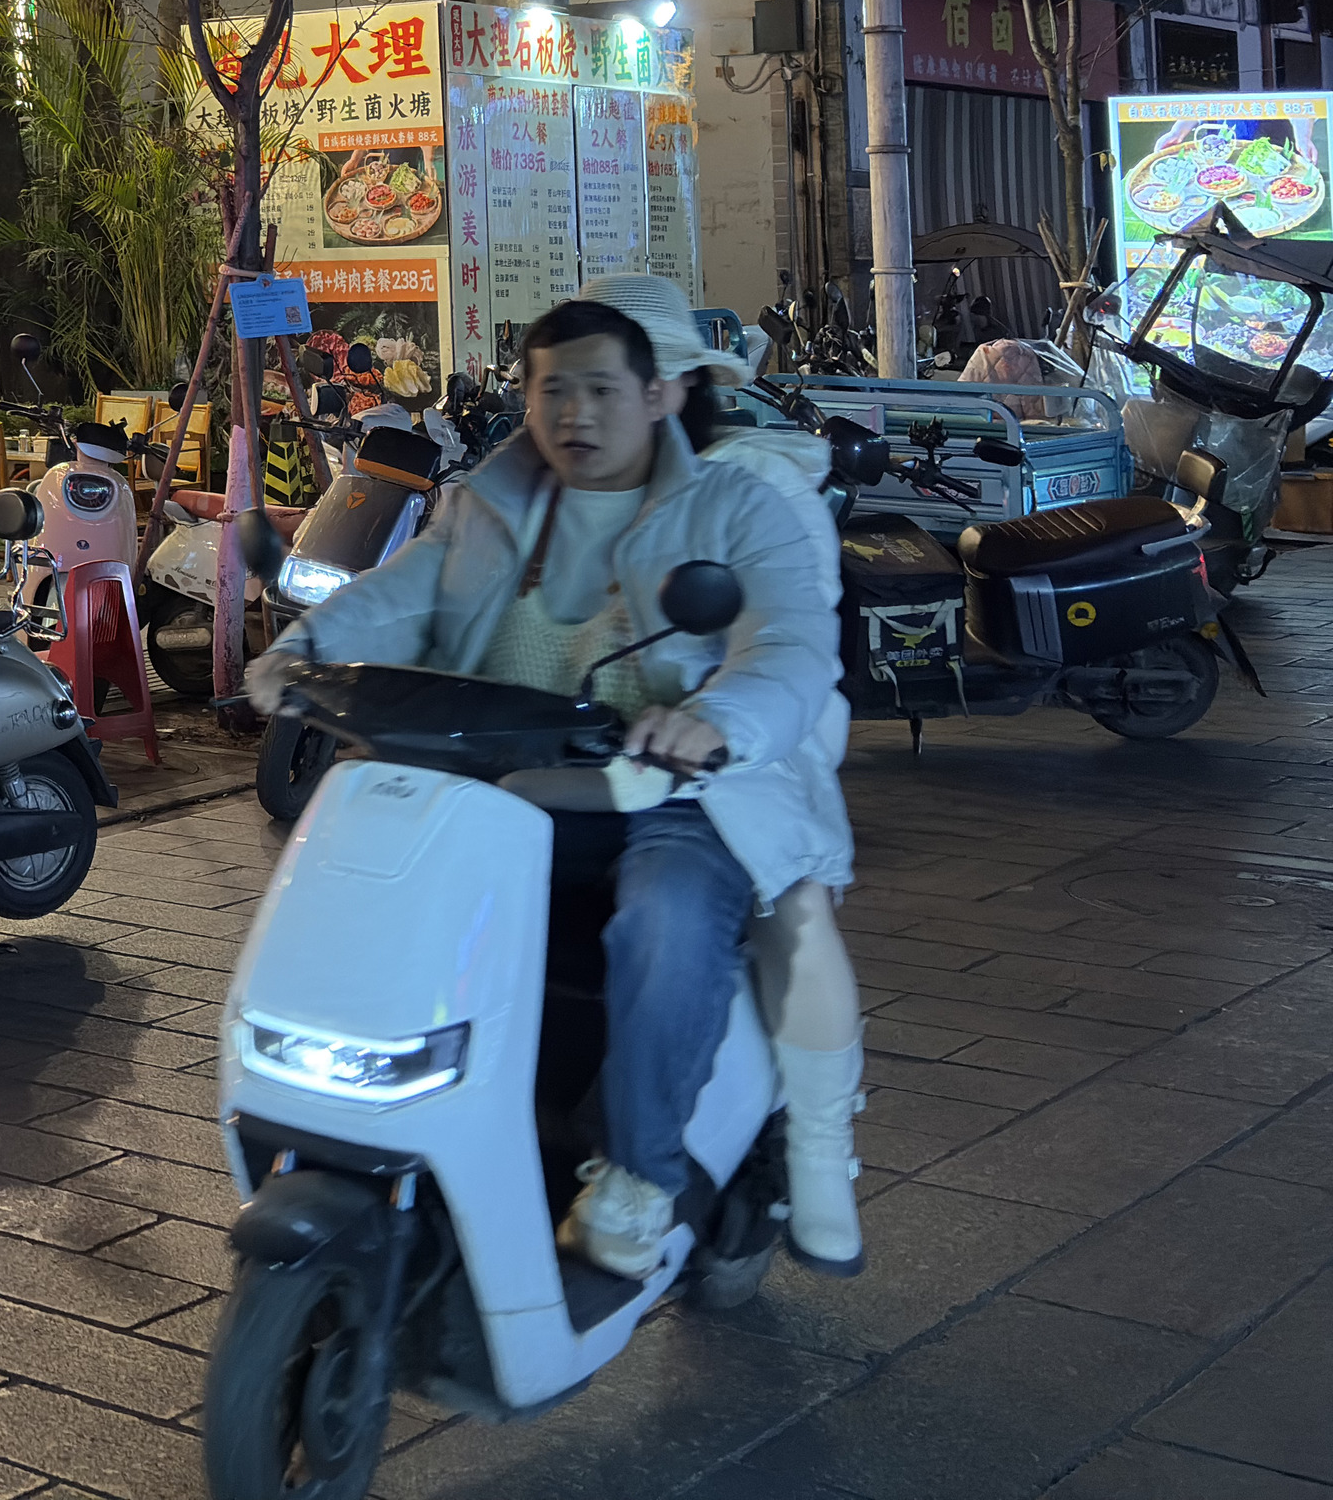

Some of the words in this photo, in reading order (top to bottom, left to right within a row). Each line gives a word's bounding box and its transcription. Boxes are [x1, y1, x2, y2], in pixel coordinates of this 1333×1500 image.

[196, 91, 431, 131] 大理板烧·野生菌火塘
[1284, 102, 1316, 116] 88元
[418, 130, 439, 142] 88元
[512, 121, 548, 146] 2人餐
[591, 128, 628, 150] 2人餐
[491, 147, 546, 173] 特价138元
[457, 117, 483, 383] 旅游美时美刻
[275, 268, 435, 296] 火锅+烤肉套餐238元
